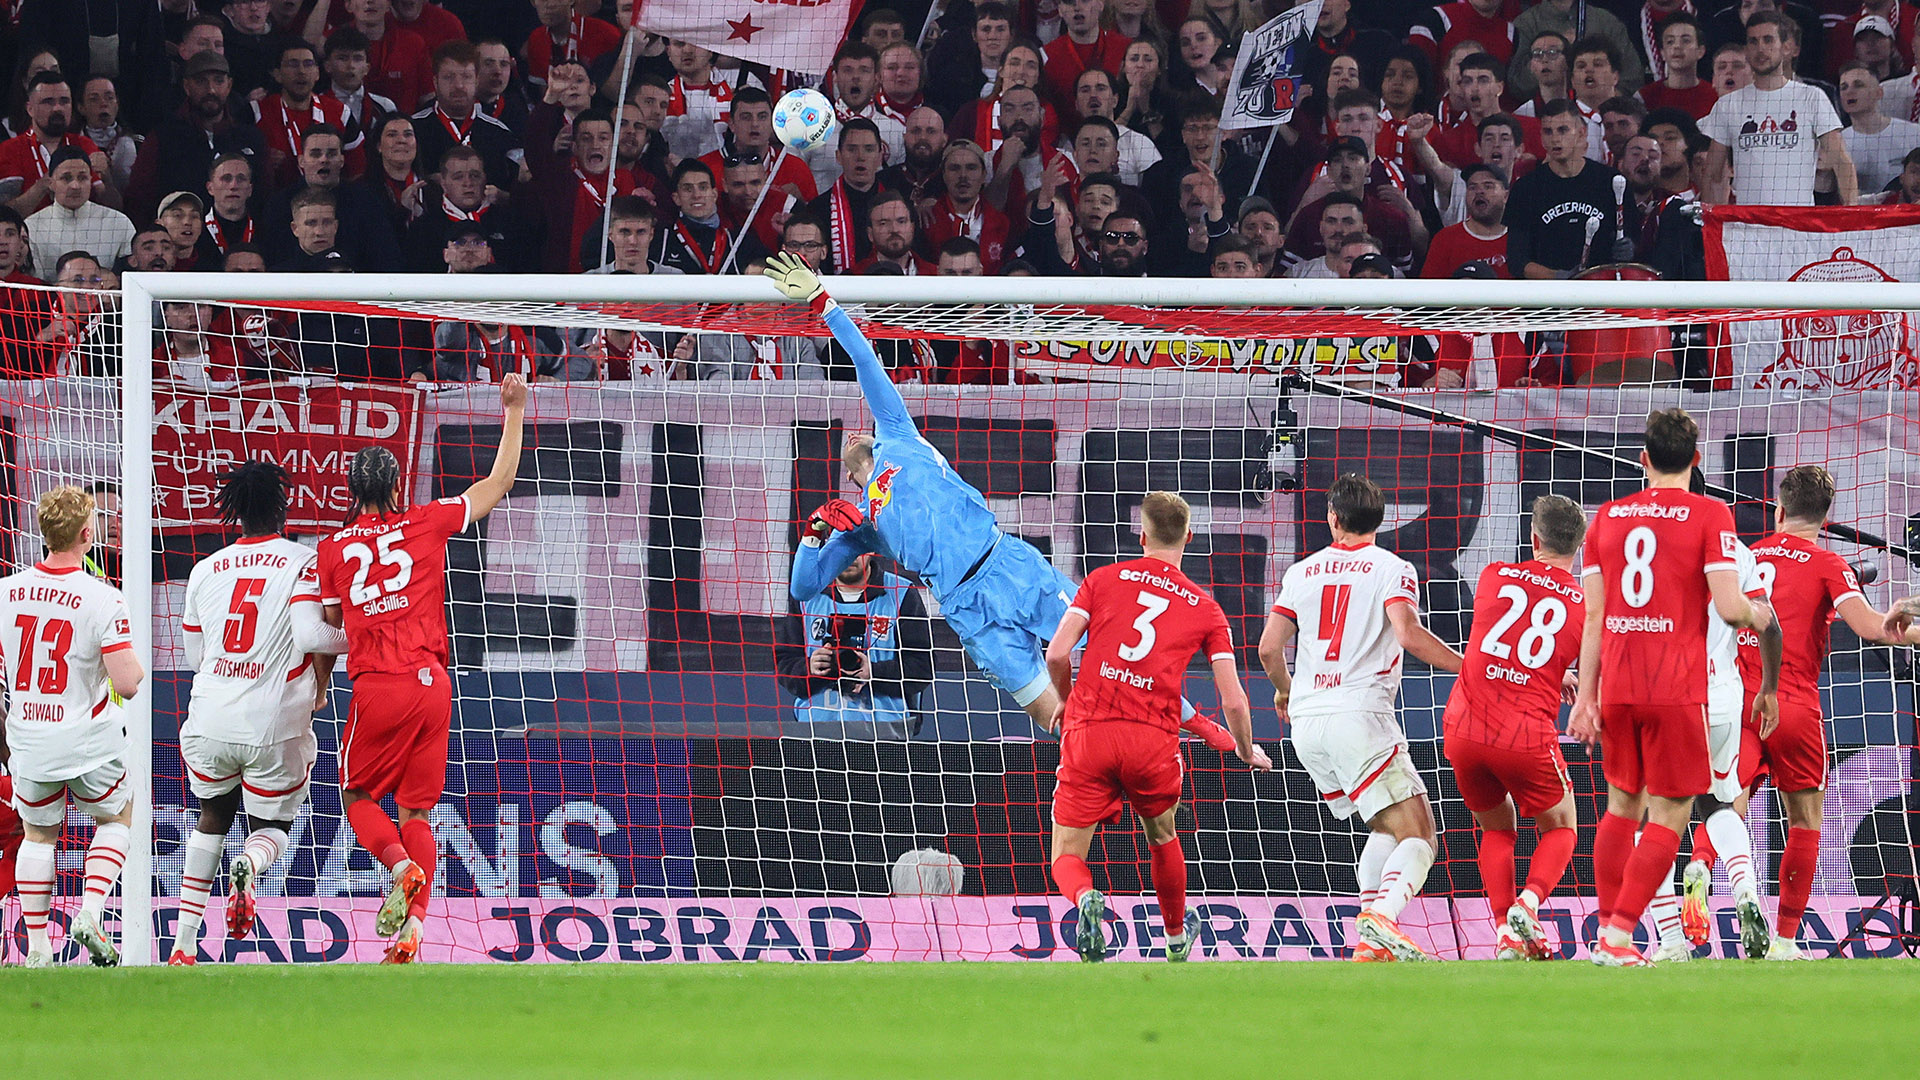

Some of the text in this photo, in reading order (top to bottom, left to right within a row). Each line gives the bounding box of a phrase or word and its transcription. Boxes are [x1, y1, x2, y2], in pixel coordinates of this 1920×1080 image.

[1254, 10, 1304, 59] NEIN
[1233, 78, 1295, 116] ZU R
[1541, 201, 1605, 225] DREIERHOPP
[152, 398, 400, 440] KHALID
[252, 448, 359, 476] IMME
[1608, 503, 1691, 521] scfreiburg
[213, 553, 288, 574] RB LEIPZIG
[342, 529, 413, 606] 25
[1305, 561, 1373, 578] RB LEIPZIG
[1621, 526, 1657, 608] 8
[10, 587, 82, 610] RB LEIPZIG
[1119, 569, 1200, 606] scfreiburg
[1498, 567, 1584, 604] scfreiburg
[222, 578, 267, 653] 5
[363, 594, 409, 616] sildillia
[1317, 584, 1352, 662] 4
[1118, 590, 1170, 662] 3
[1480, 584, 1567, 669] 28
[1605, 614, 1674, 634] eggestein
[15, 614, 73, 694] 13
[1100, 661, 1154, 690] lienhart
[1485, 664, 1531, 685] ginter
[23, 701, 64, 722] SEIWALD
[488, 906, 871, 962] JOBRAD
